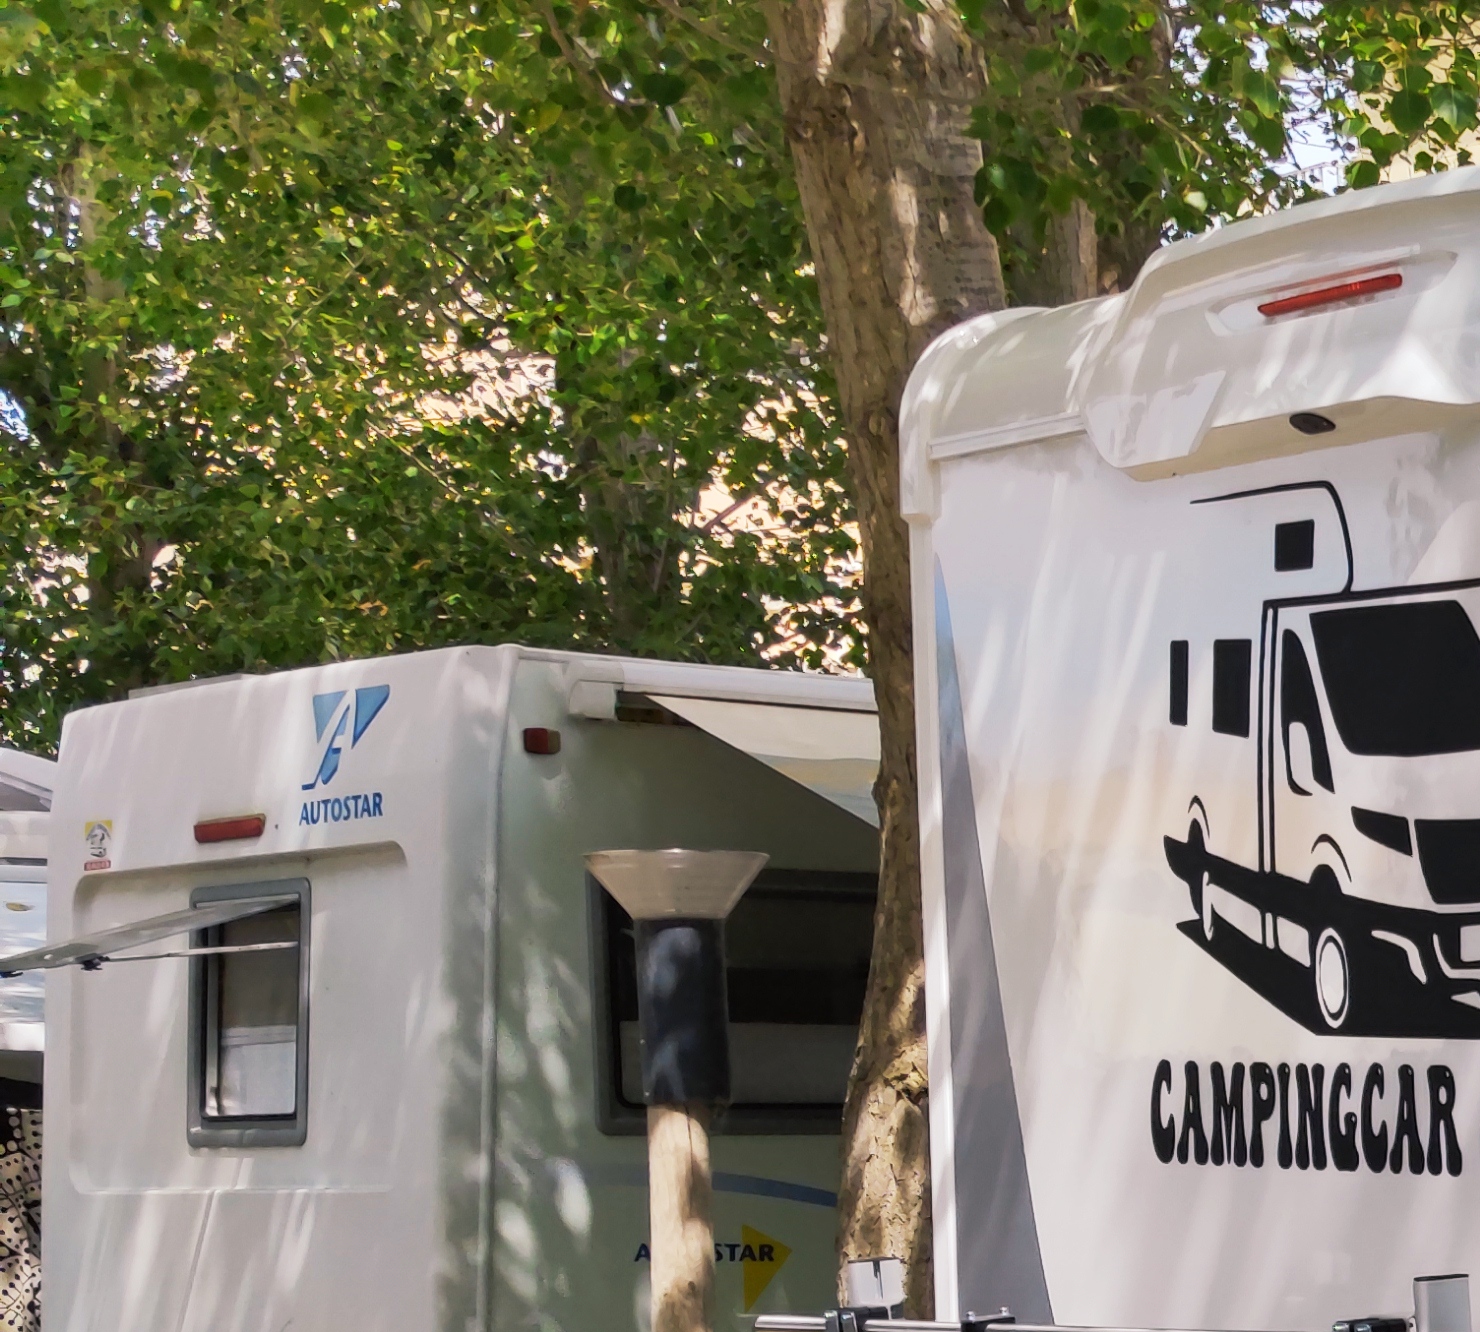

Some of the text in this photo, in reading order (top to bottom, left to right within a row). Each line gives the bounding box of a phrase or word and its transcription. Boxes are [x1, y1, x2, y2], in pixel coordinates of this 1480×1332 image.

[299, 791, 384, 826] AUTOSTAR
[1150, 1058, 1464, 1177] CAMPINGCAR
[634, 1243, 776, 1263] ASTAR
